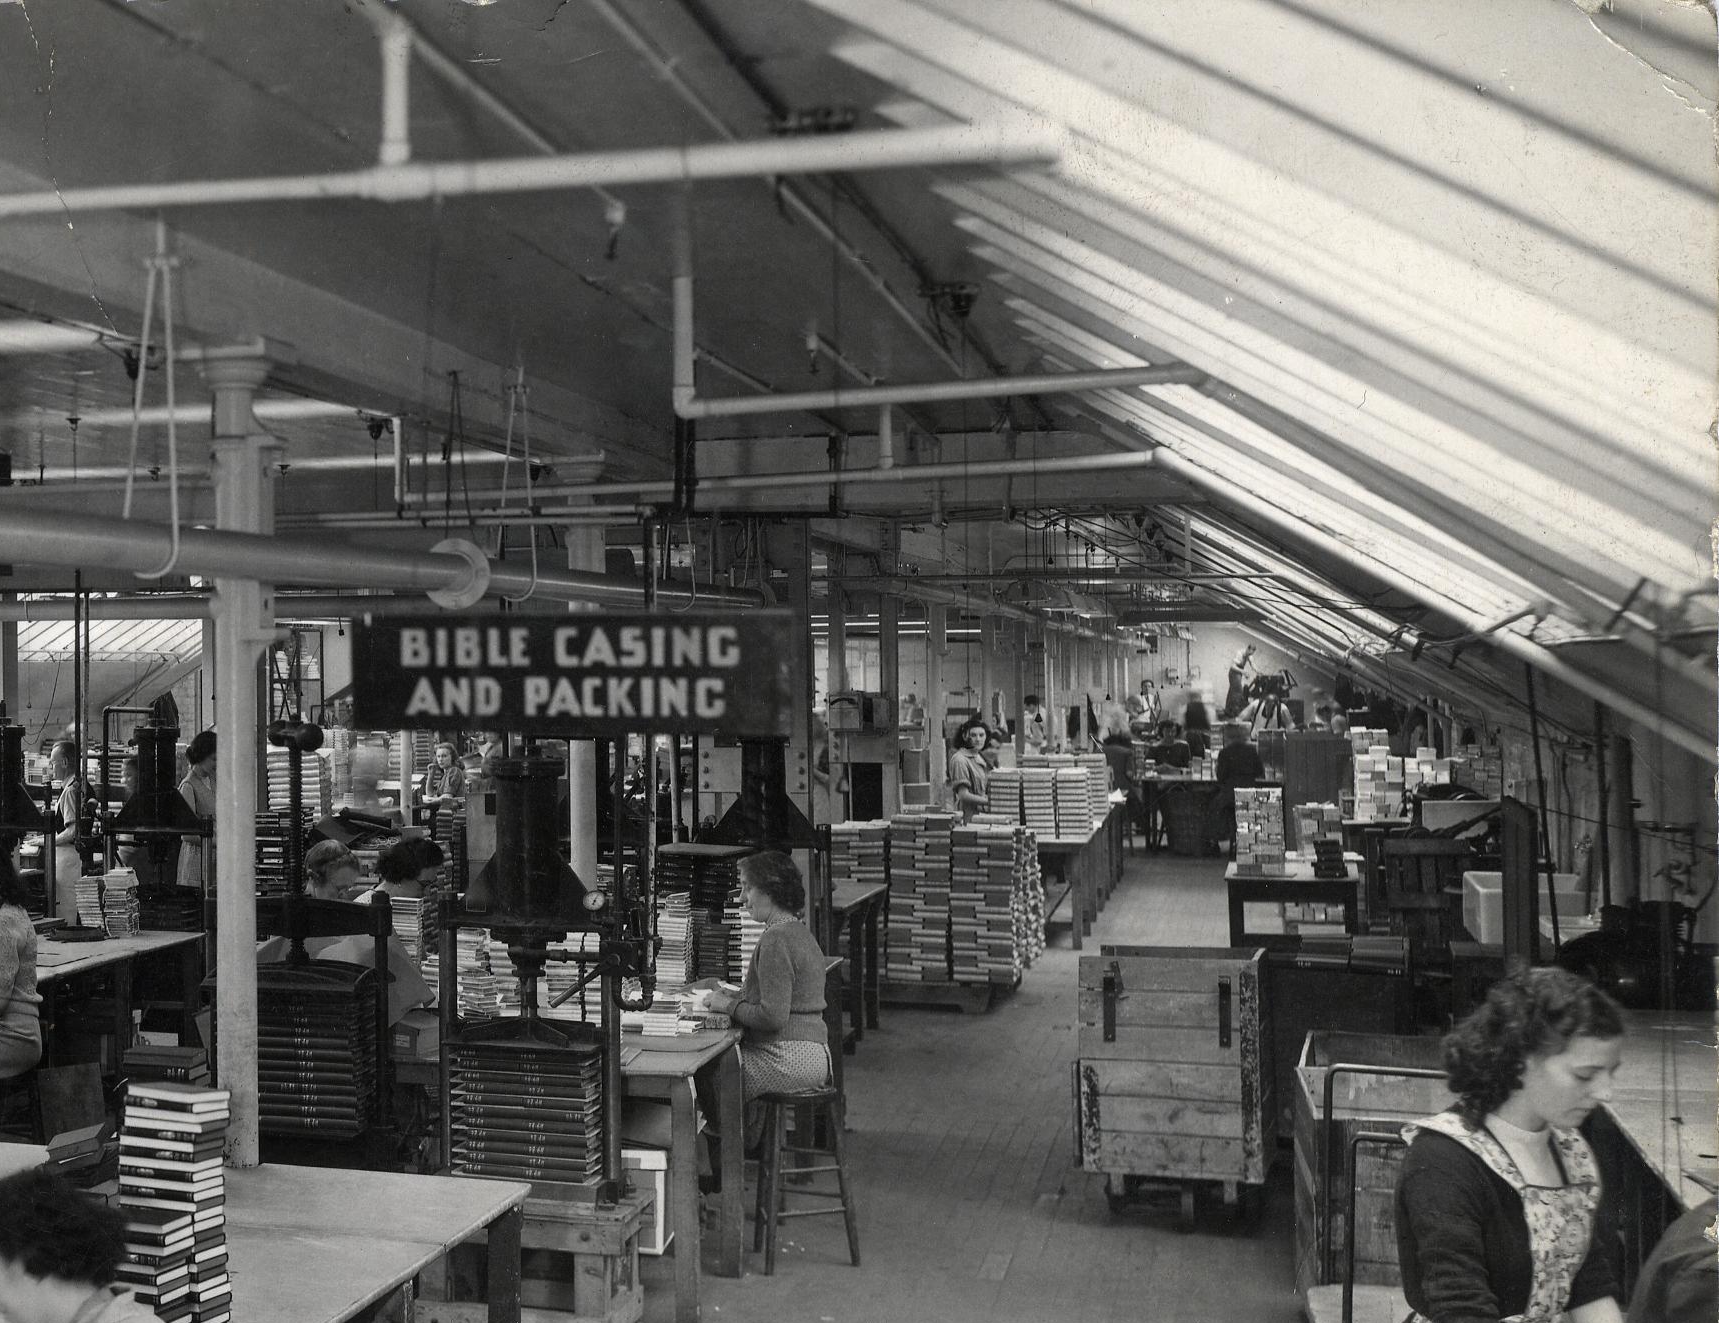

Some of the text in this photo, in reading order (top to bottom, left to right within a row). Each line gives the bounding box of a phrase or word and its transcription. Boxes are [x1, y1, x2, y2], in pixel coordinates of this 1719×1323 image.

[399, 626, 742, 668] BIBLE CASING
[404, 676, 726, 719] AND PACKING
